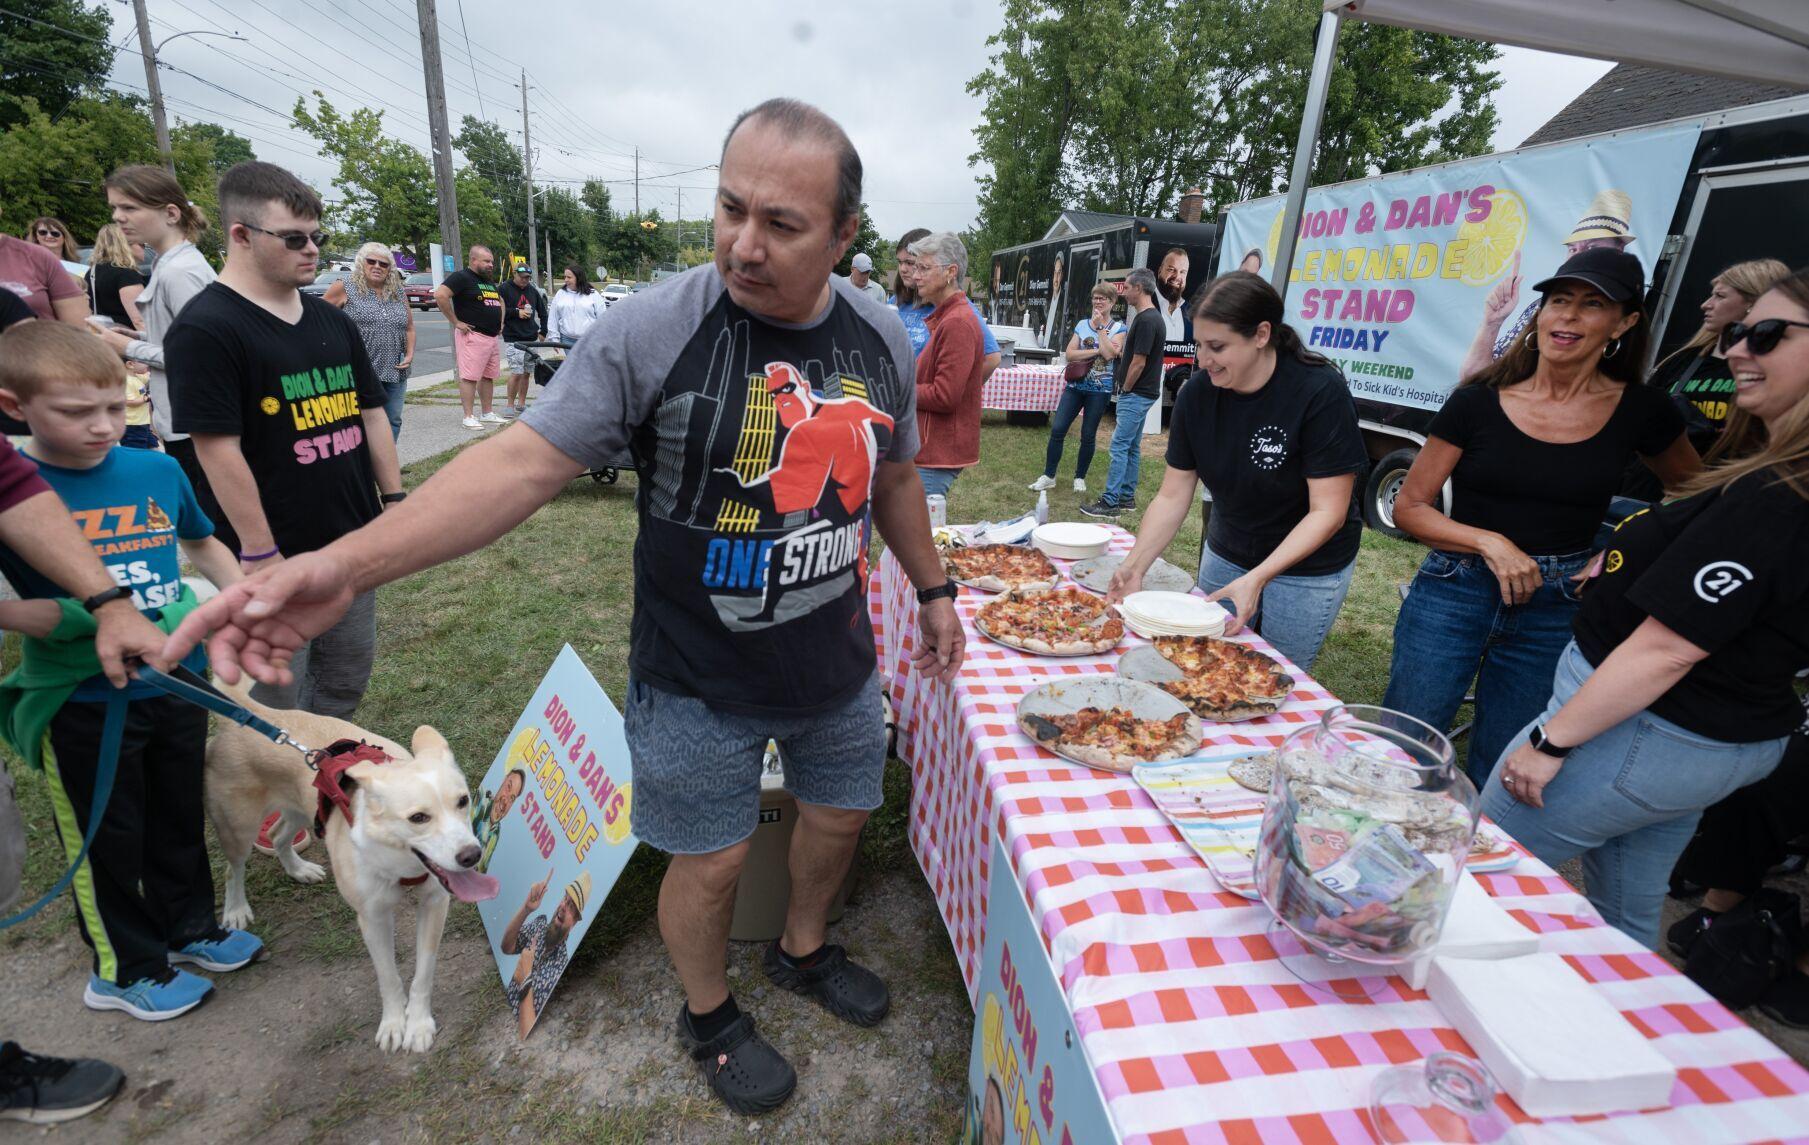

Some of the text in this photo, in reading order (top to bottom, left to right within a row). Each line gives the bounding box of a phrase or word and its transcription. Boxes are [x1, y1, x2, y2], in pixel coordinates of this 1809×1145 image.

[1298, 184, 1496, 240] ION & DAN'S
[1300, 288, 1416, 323] STAND
[1163, 342, 1198, 353] emmiti
[1308, 326, 1390, 353] FRIDAY
[281, 371, 315, 401] DION
[312, 367, 328, 395] &
[1351, 360, 1415, 381] WEEKEND
[1353, 379, 1363, 390] To
[1364, 380, 1381, 394] Sick
[1382, 384, 1405, 398] Kid's
[293, 425, 362, 465] STAND
[71, 505, 146, 540] ZZ
[95, 534, 174, 557] EAKFAST?
[106, 560, 161, 587] ES,
[703, 538, 774, 589] ONE
[543, 694, 625, 826] DION & DAN'S
[522, 728, 599, 864] LEMONADE
[520, 791, 556, 860] STAND
[1000, 940, 1055, 1136] DION &
